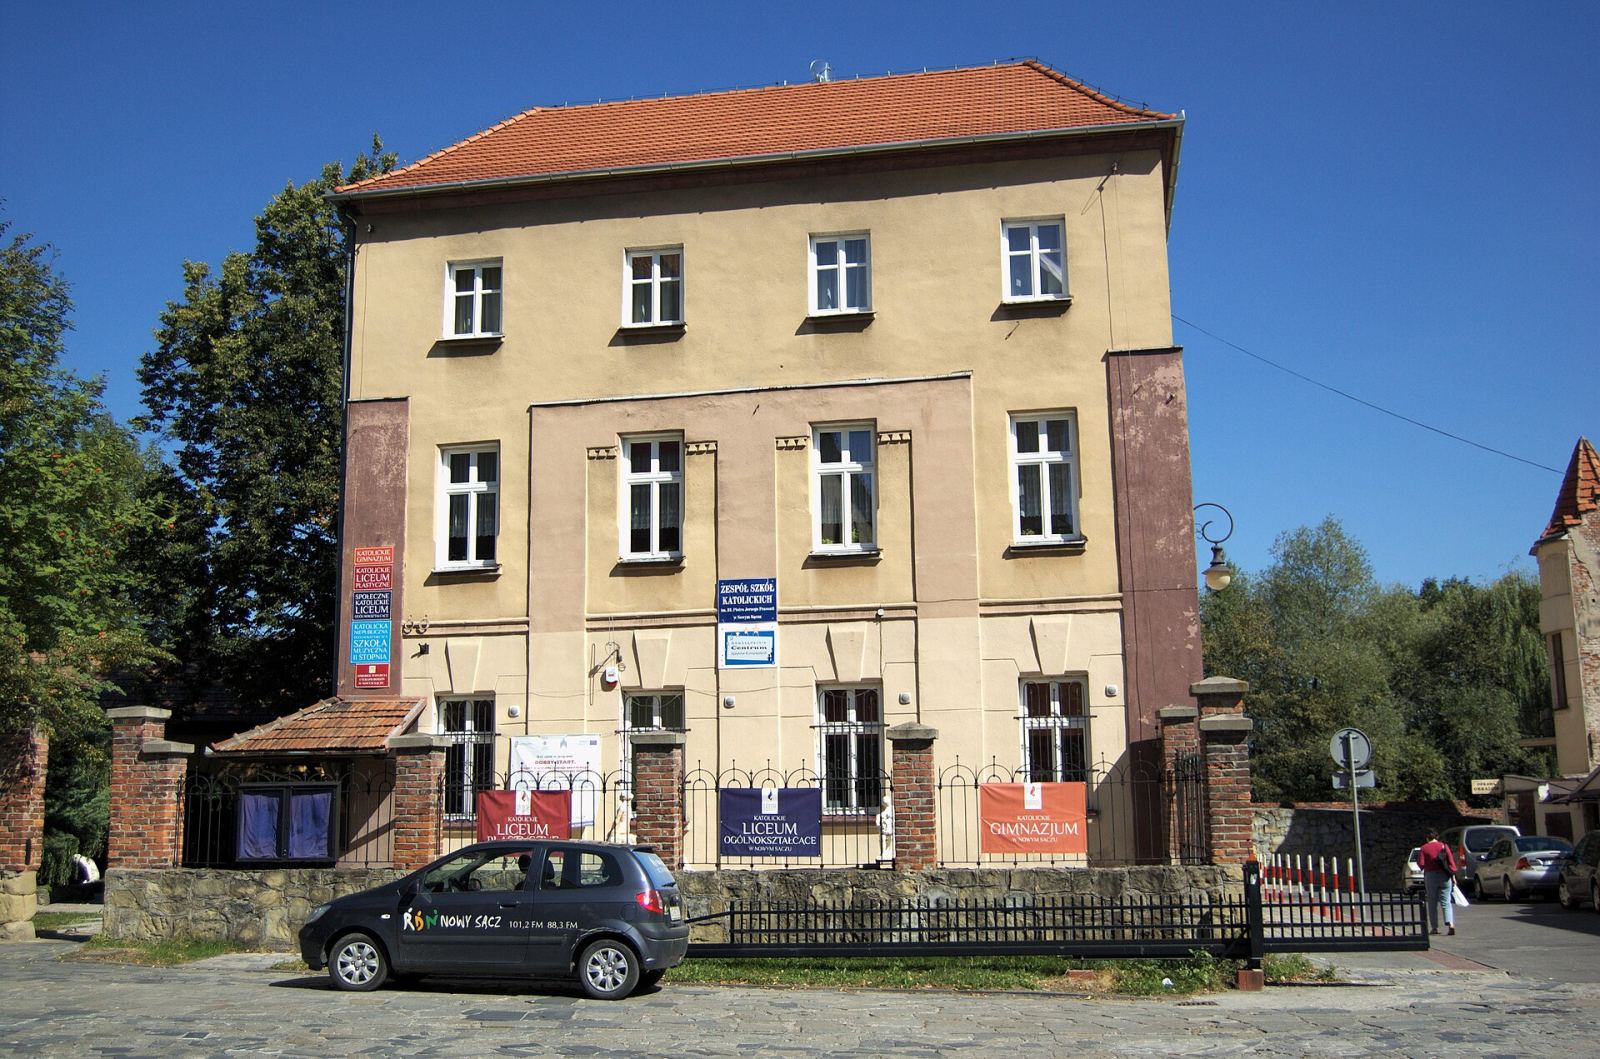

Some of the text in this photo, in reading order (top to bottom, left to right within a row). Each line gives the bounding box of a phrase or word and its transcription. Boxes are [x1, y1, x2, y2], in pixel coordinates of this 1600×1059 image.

[356, 574, 390, 582] LICEUM
[720, 582, 774, 593] ZESPÓŁ SZKÓŁ
[722, 595, 772, 604] KATOLICKICH
[355, 606, 389, 614] LICEUM
[353, 639, 388, 648] SZKOŁA
[496, 823, 549, 836] LICEUM
[742, 822, 798, 835] LICEUM
[990, 822, 1078, 836] GIMNAZJUM
[724, 835, 816, 845] OGÓLNOKSZTAŁCĄCE
[440, 915, 472, 928] NOWY
[475, 915, 502, 930] SĄCZ
[547, 921, 564, 929] 88,3
